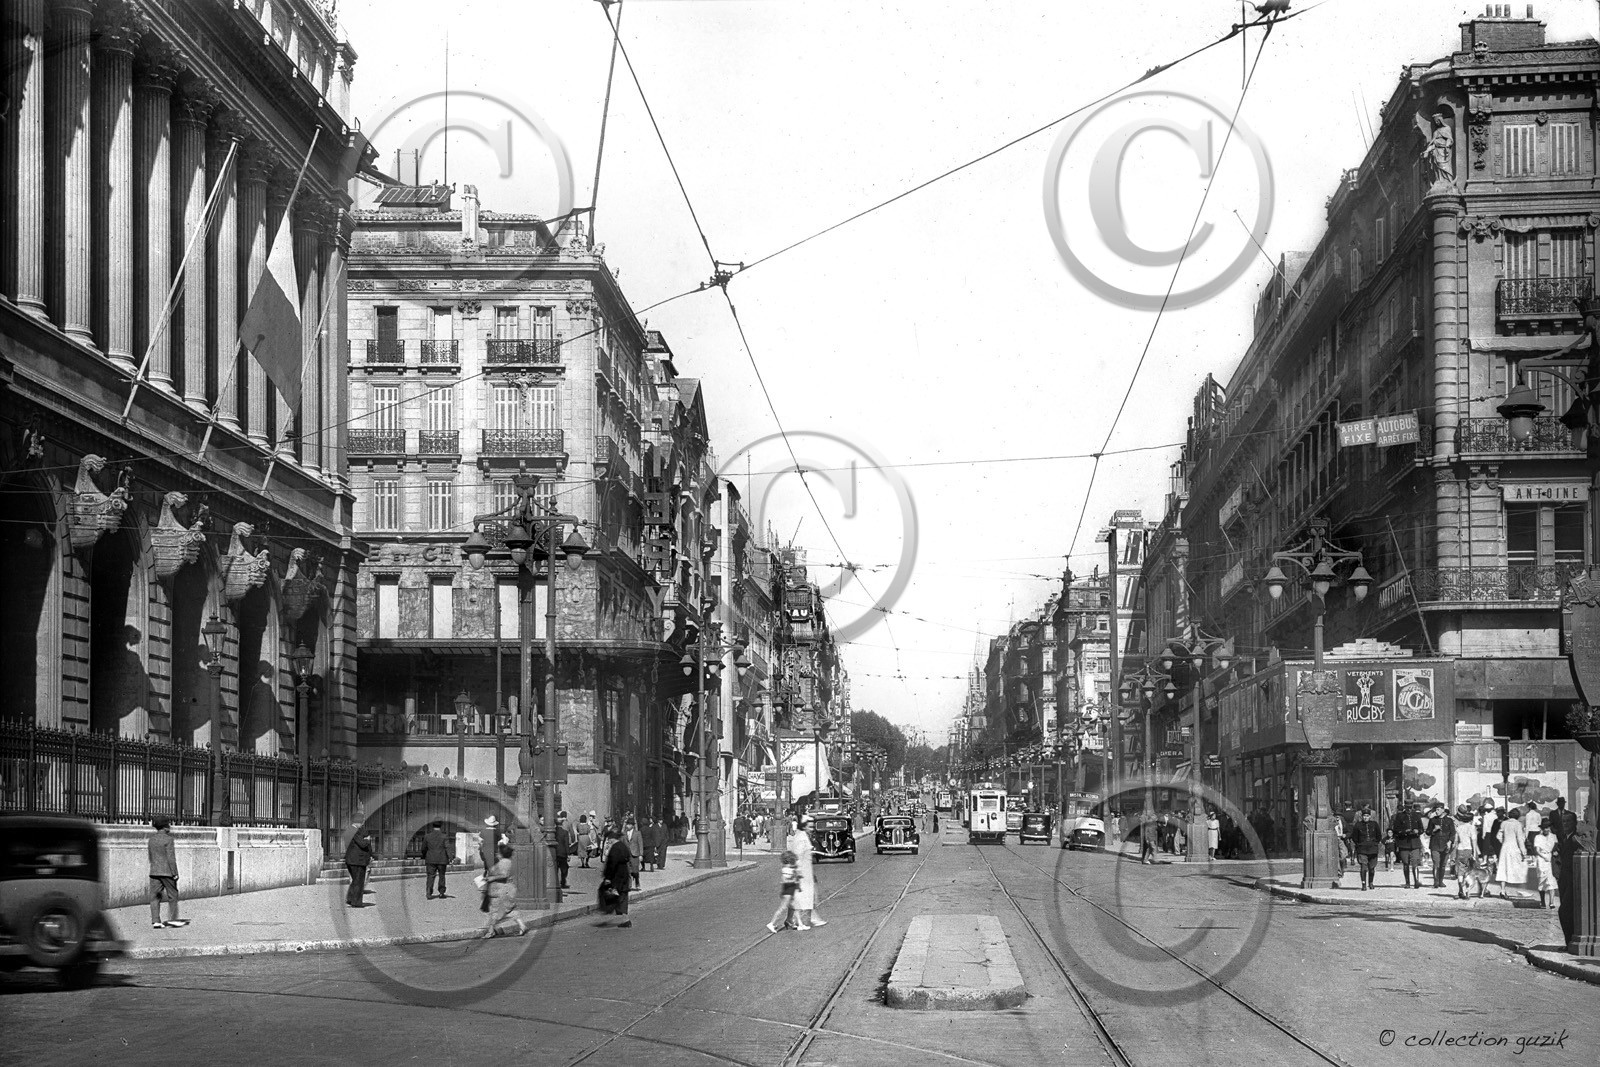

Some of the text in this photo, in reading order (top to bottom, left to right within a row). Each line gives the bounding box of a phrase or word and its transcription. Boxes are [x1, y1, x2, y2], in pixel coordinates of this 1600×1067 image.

[1377, 418, 1418, 432] AUTOBUS
[1344, 433, 1372, 444] FIXE
[1402, 431, 1419, 442] FIXE
[1516, 487, 1579, 499] ANTOINE
[393, 553, 409, 562] ET
[1346, 705, 1385, 720] RUGBY
[1521, 757, 1540, 771] FILS
